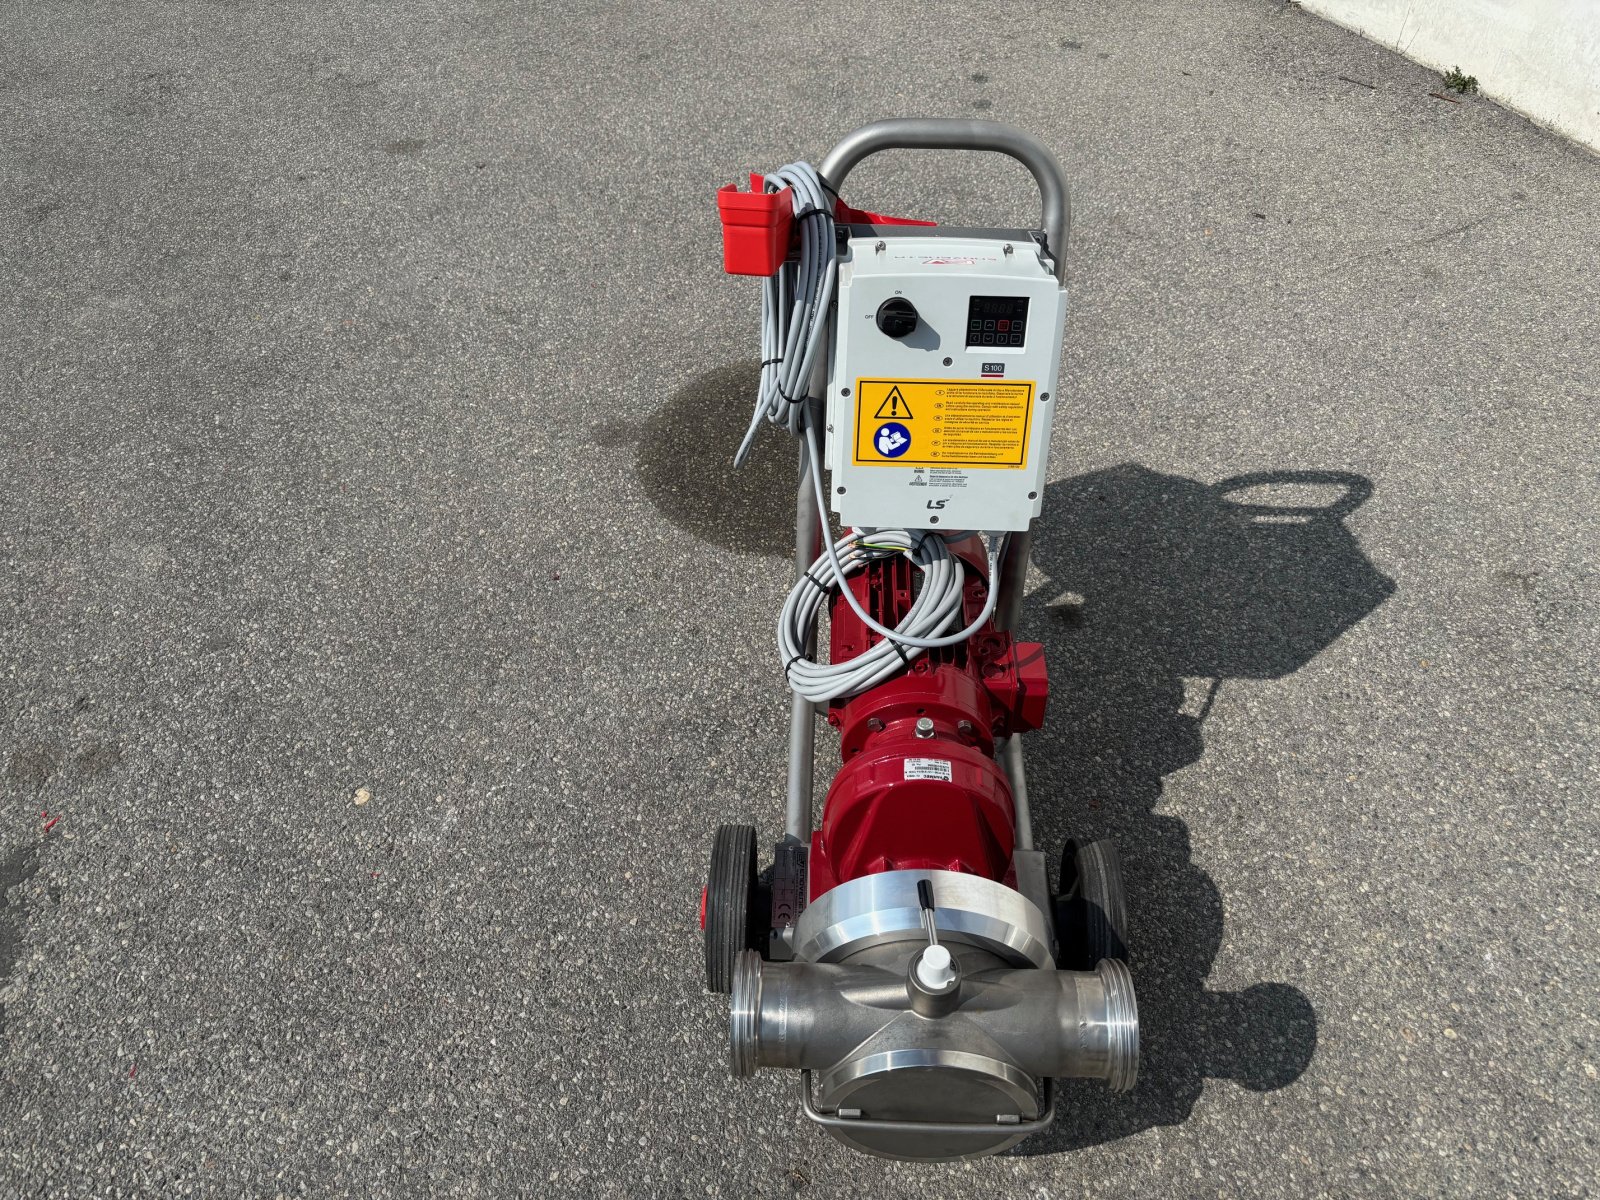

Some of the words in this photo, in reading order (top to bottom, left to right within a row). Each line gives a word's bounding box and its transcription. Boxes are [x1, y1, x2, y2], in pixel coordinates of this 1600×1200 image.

[984, 364, 990, 372] S
[990, 364, 1003, 372] 100
[926, 499, 946, 510] LS
